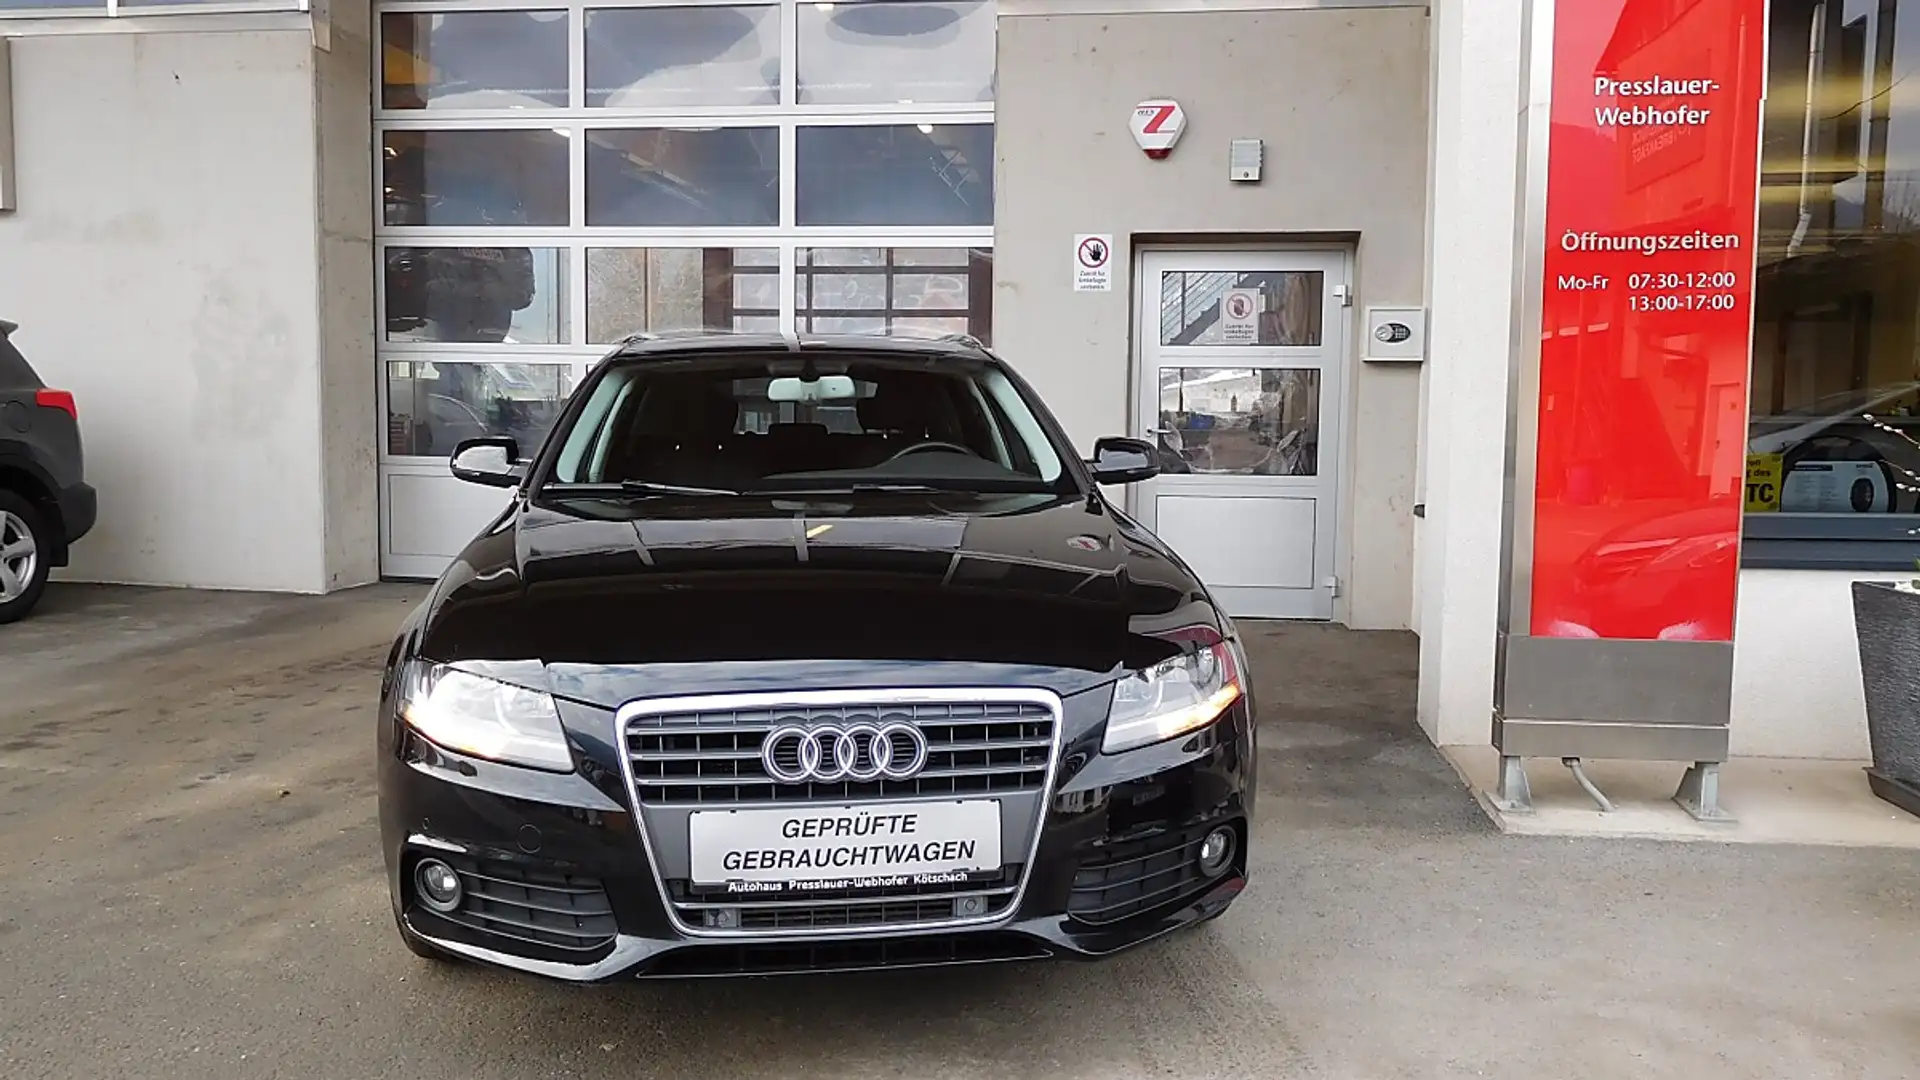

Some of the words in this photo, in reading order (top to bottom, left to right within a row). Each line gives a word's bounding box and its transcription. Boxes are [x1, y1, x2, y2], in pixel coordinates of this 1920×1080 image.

[1594, 75, 1720, 96] Presslauer-
[1594, 105, 1711, 126] Webhofer
[1561, 229, 1740, 255] Öffnungszeiten
[1558, 275, 1609, 290] Mo-Fr
[1628, 272, 1736, 290] 07:30-12:00
[1629, 294, 1735, 311] 13:00-17:00
[782, 812, 917, 839] GEPRÜFTE
[723, 840, 976, 871] GEBRAUCHTWAGEN
[728, 881, 782, 892] Autohaus
[789, 875, 908, 890] Presslauer-Webhofer
[913, 872, 968, 885] Kötschach
